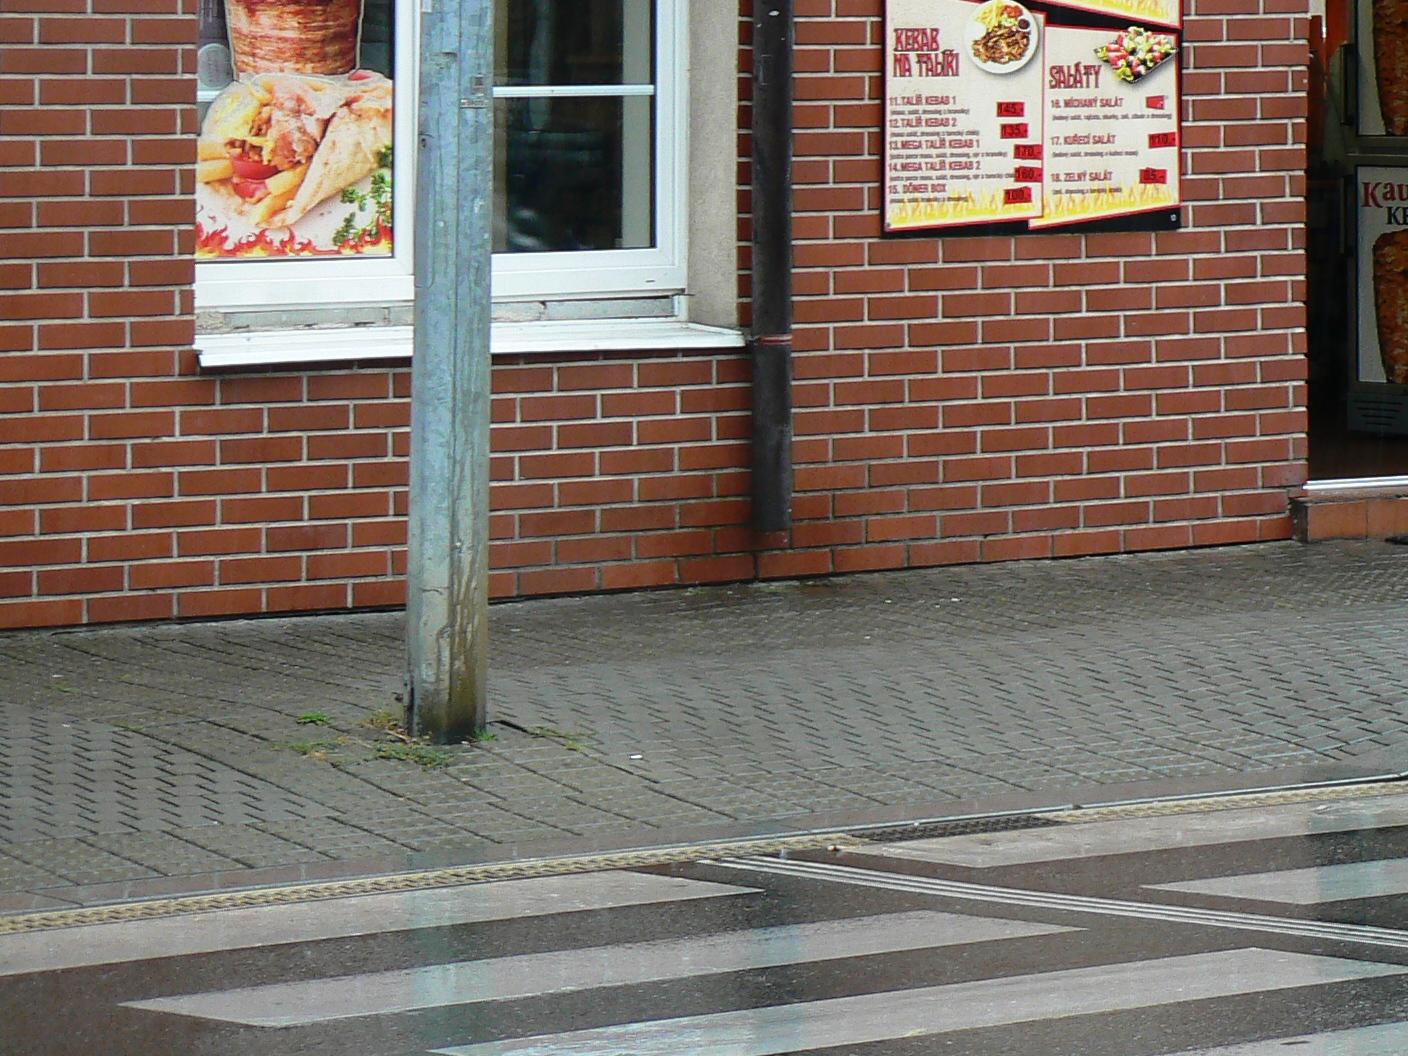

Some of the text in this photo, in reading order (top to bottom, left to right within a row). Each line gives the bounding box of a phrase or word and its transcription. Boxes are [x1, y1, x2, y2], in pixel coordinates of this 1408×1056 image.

[893, 27, 940, 52] KEBAB
[893, 53, 912, 77] NA
[1049, 61, 1102, 89] SALÁTY
